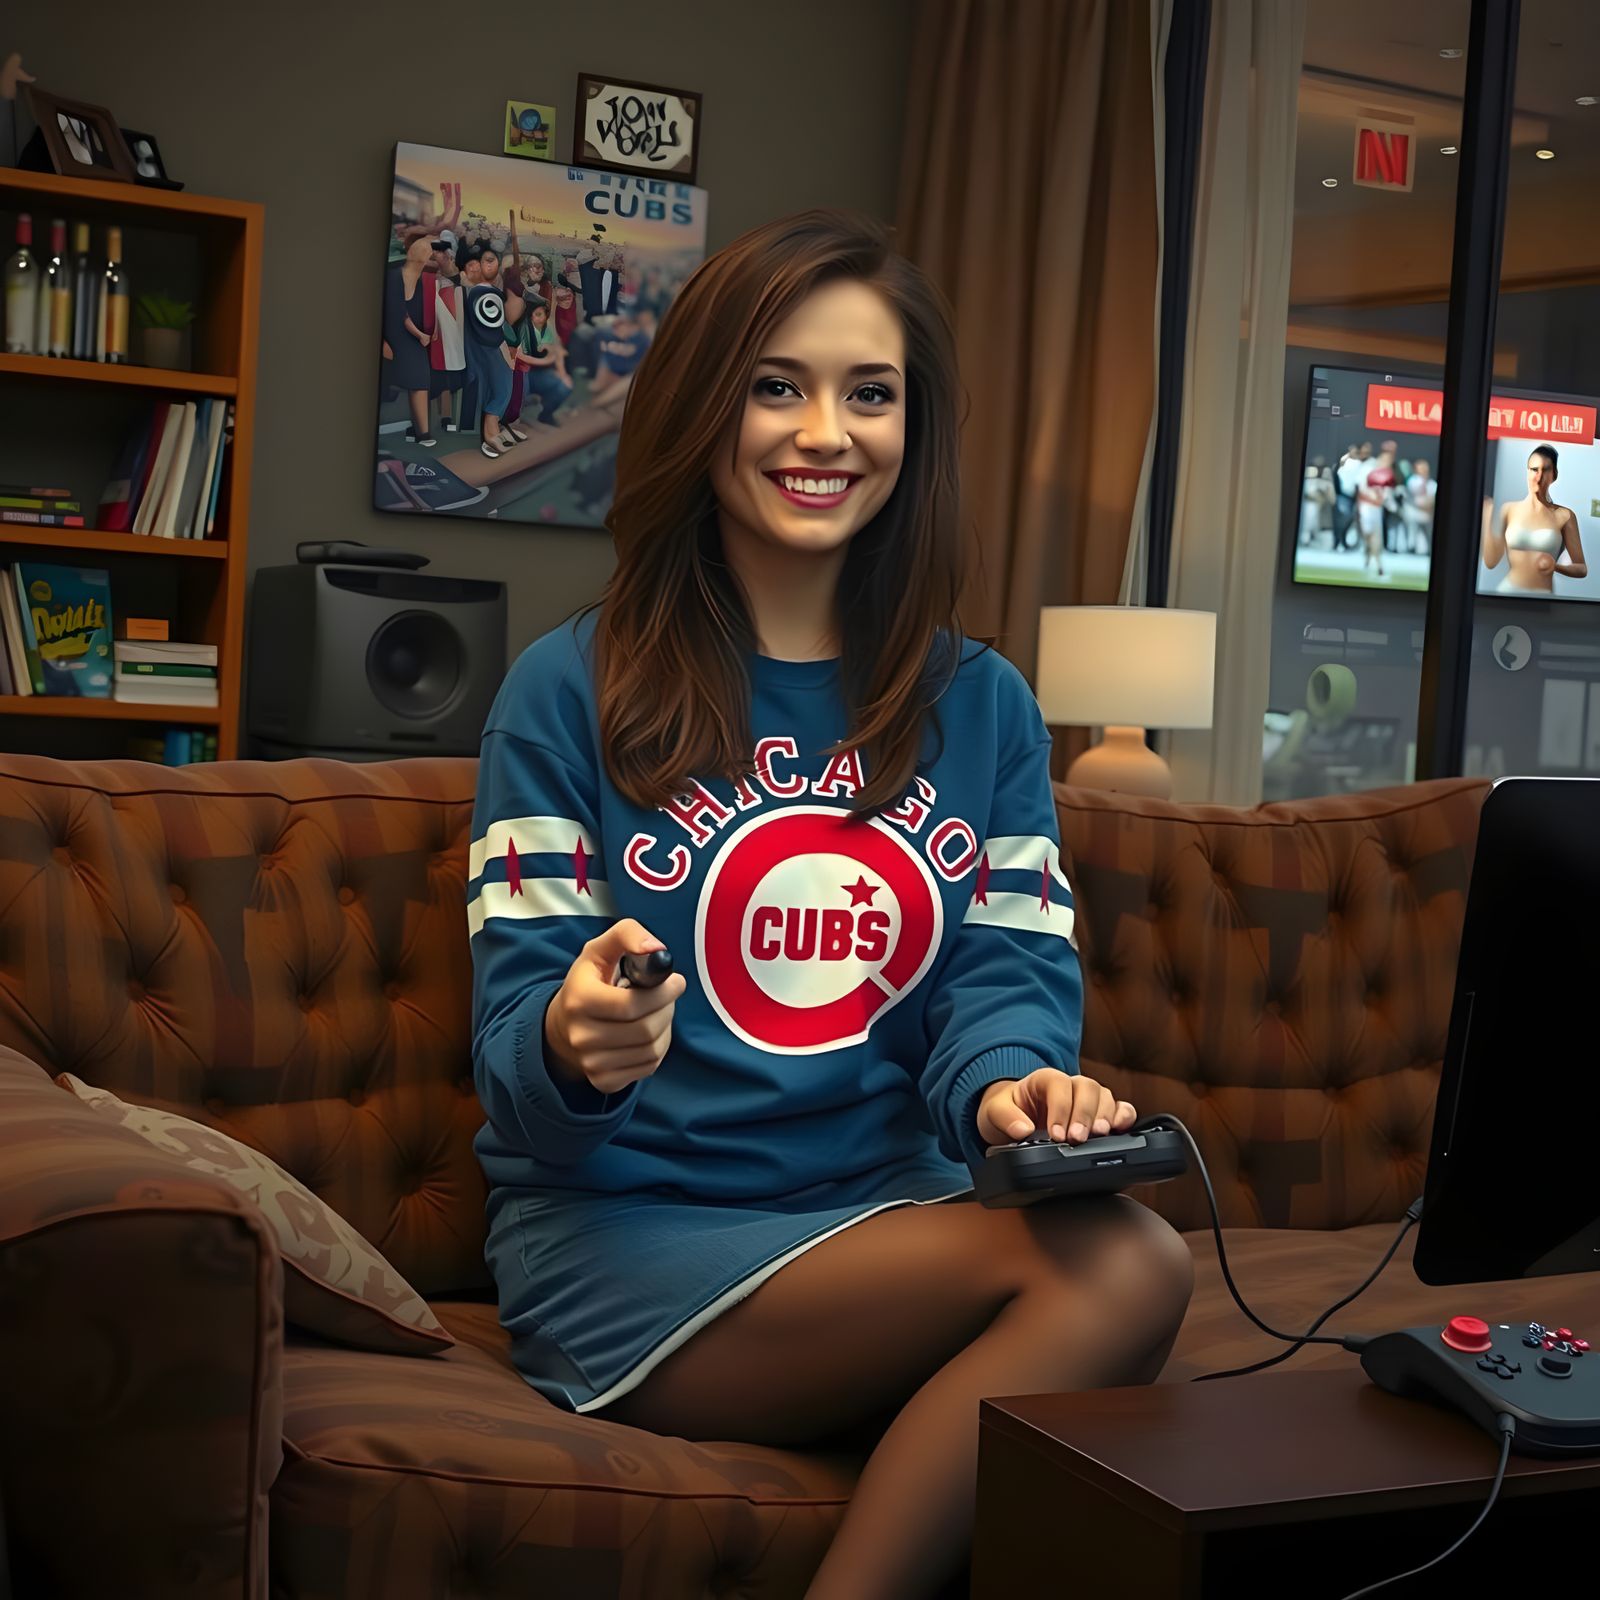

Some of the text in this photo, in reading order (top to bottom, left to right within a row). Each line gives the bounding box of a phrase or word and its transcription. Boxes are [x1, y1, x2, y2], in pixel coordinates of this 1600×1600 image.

[584, 190, 692, 225] CUBS
[624, 737, 977, 891] CHICAGO
[750, 906, 890, 961] CUBS
